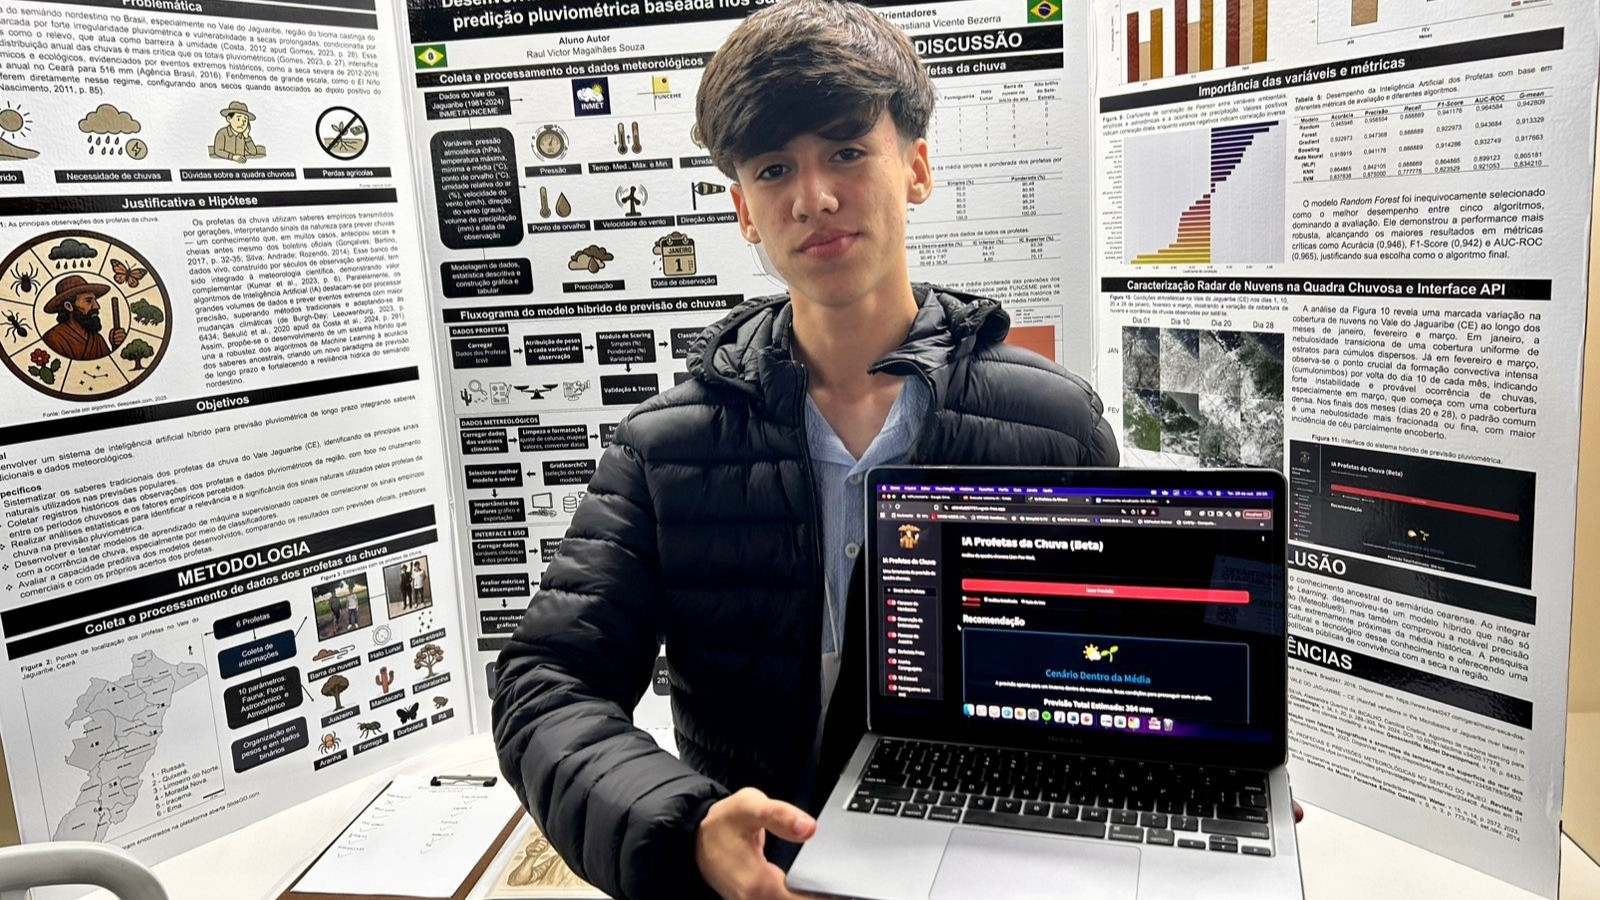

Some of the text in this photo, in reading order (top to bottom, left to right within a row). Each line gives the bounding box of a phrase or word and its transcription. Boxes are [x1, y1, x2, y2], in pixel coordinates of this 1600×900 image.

[122, 0, 203, 12] Problemática
[453, 0, 713, 30] predição pluviométrica baseada
[932, 18, 965, 28] Vicente
[967, 15, 1001, 25] Bezerra
[558, 34, 610, 45] Aluno Autor
[915, 31, 1022, 55] DISCUSSÃO
[526, 43, 645, 58] Raul Victor Magalhães Souza
[439, 56, 703, 83] Coleta e processamento dos dados meteorológicos
[956, 63, 970, 74] da
[972, 61, 1006, 74] chuva
[1198, 58, 1405, 97] Importância das variáveis e métricas
[438, 92, 459, 100] Dados
[432, 101, 463, 110] Jaguaribe
[581, 101, 603, 109] INMET
[439, 107, 498, 117] INMET/FUNCEME
[66, 172, 119, 180] Necessidade
[181, 171, 212, 179] Dúvidas
[213, 170, 233, 178] sobre
[241, 170, 265, 179] quadra
[346, 169, 373, 178] agrícolas
[121, 195, 257, 208] Justificativa e Hipótese
[1302, 187, 1545, 207] O modelo Random Forest foi inequivocamente selecionado
[574, 282, 613, 290] Precipitação
[678, 277, 716, 287] observação
[1126, 280, 1505, 295] Caracterização Radar de Nuvens na Quadra Chuvosa e Interface API
[460, 299, 726, 322] Fluxograma do modelo híbrido de previsão de chuvas
[1170, 317, 1181, 325] Dia
[1210, 318, 1231, 327] Dia 20
[1252, 320, 1274, 329] Dia 28
[196, 396, 249, 411] Objetivos
[1353, 422, 1402, 434] parcialmente
[1403, 428, 1446, 439] encoberto.
[12, 547, 38, 558] chuva
[40, 544, 51, 552] na
[53, 536, 88, 551] previsão
[961, 536, 1103, 552] IA Profetas da Chuva (Beta)
[177, 540, 310, 586] METODOLOGIA
[1288, 550, 1347, 576] USÃO
[85, 546, 387, 634] Coleta e processamento de dados dos profetas da chuva
[242, 613, 270, 625] Profetas
[962, 614, 1025, 627] Recomendação
[241, 646, 263, 657] Coleta
[370, 644, 401, 659] Halo Lunar
[238, 650, 278, 667] informações
[309, 670, 327, 680] Barra
[336, 659, 358, 670] nuvens
[1045, 668, 1150, 683] Cenário Dentro da Média
[238, 687, 246, 695] 10
[240, 694, 281, 712] Astronômico
[1043, 698, 1072, 707] Previsão
[1072, 700, 1090, 708] Total
[246, 701, 285, 719] Atmosférico
[319, 754, 341, 766] Aranha
